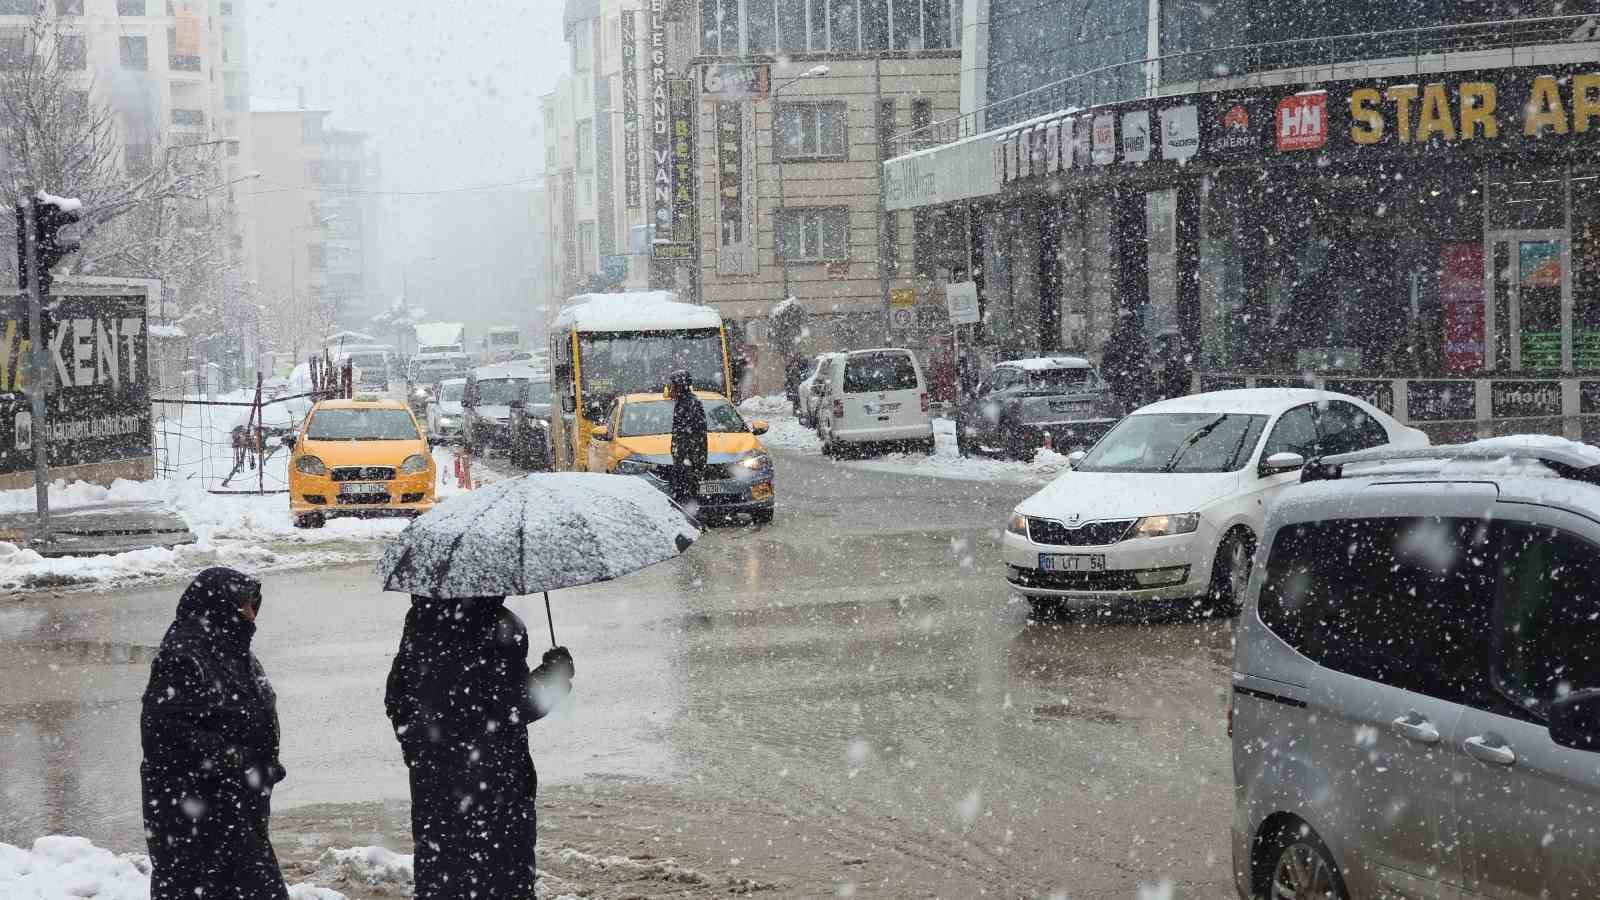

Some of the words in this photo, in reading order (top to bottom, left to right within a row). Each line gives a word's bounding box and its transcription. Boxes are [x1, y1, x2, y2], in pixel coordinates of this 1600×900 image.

[1350, 83, 1497, 144] STAR
[655, 150, 669, 201] VAN
[49, 318, 143, 389] KENT
